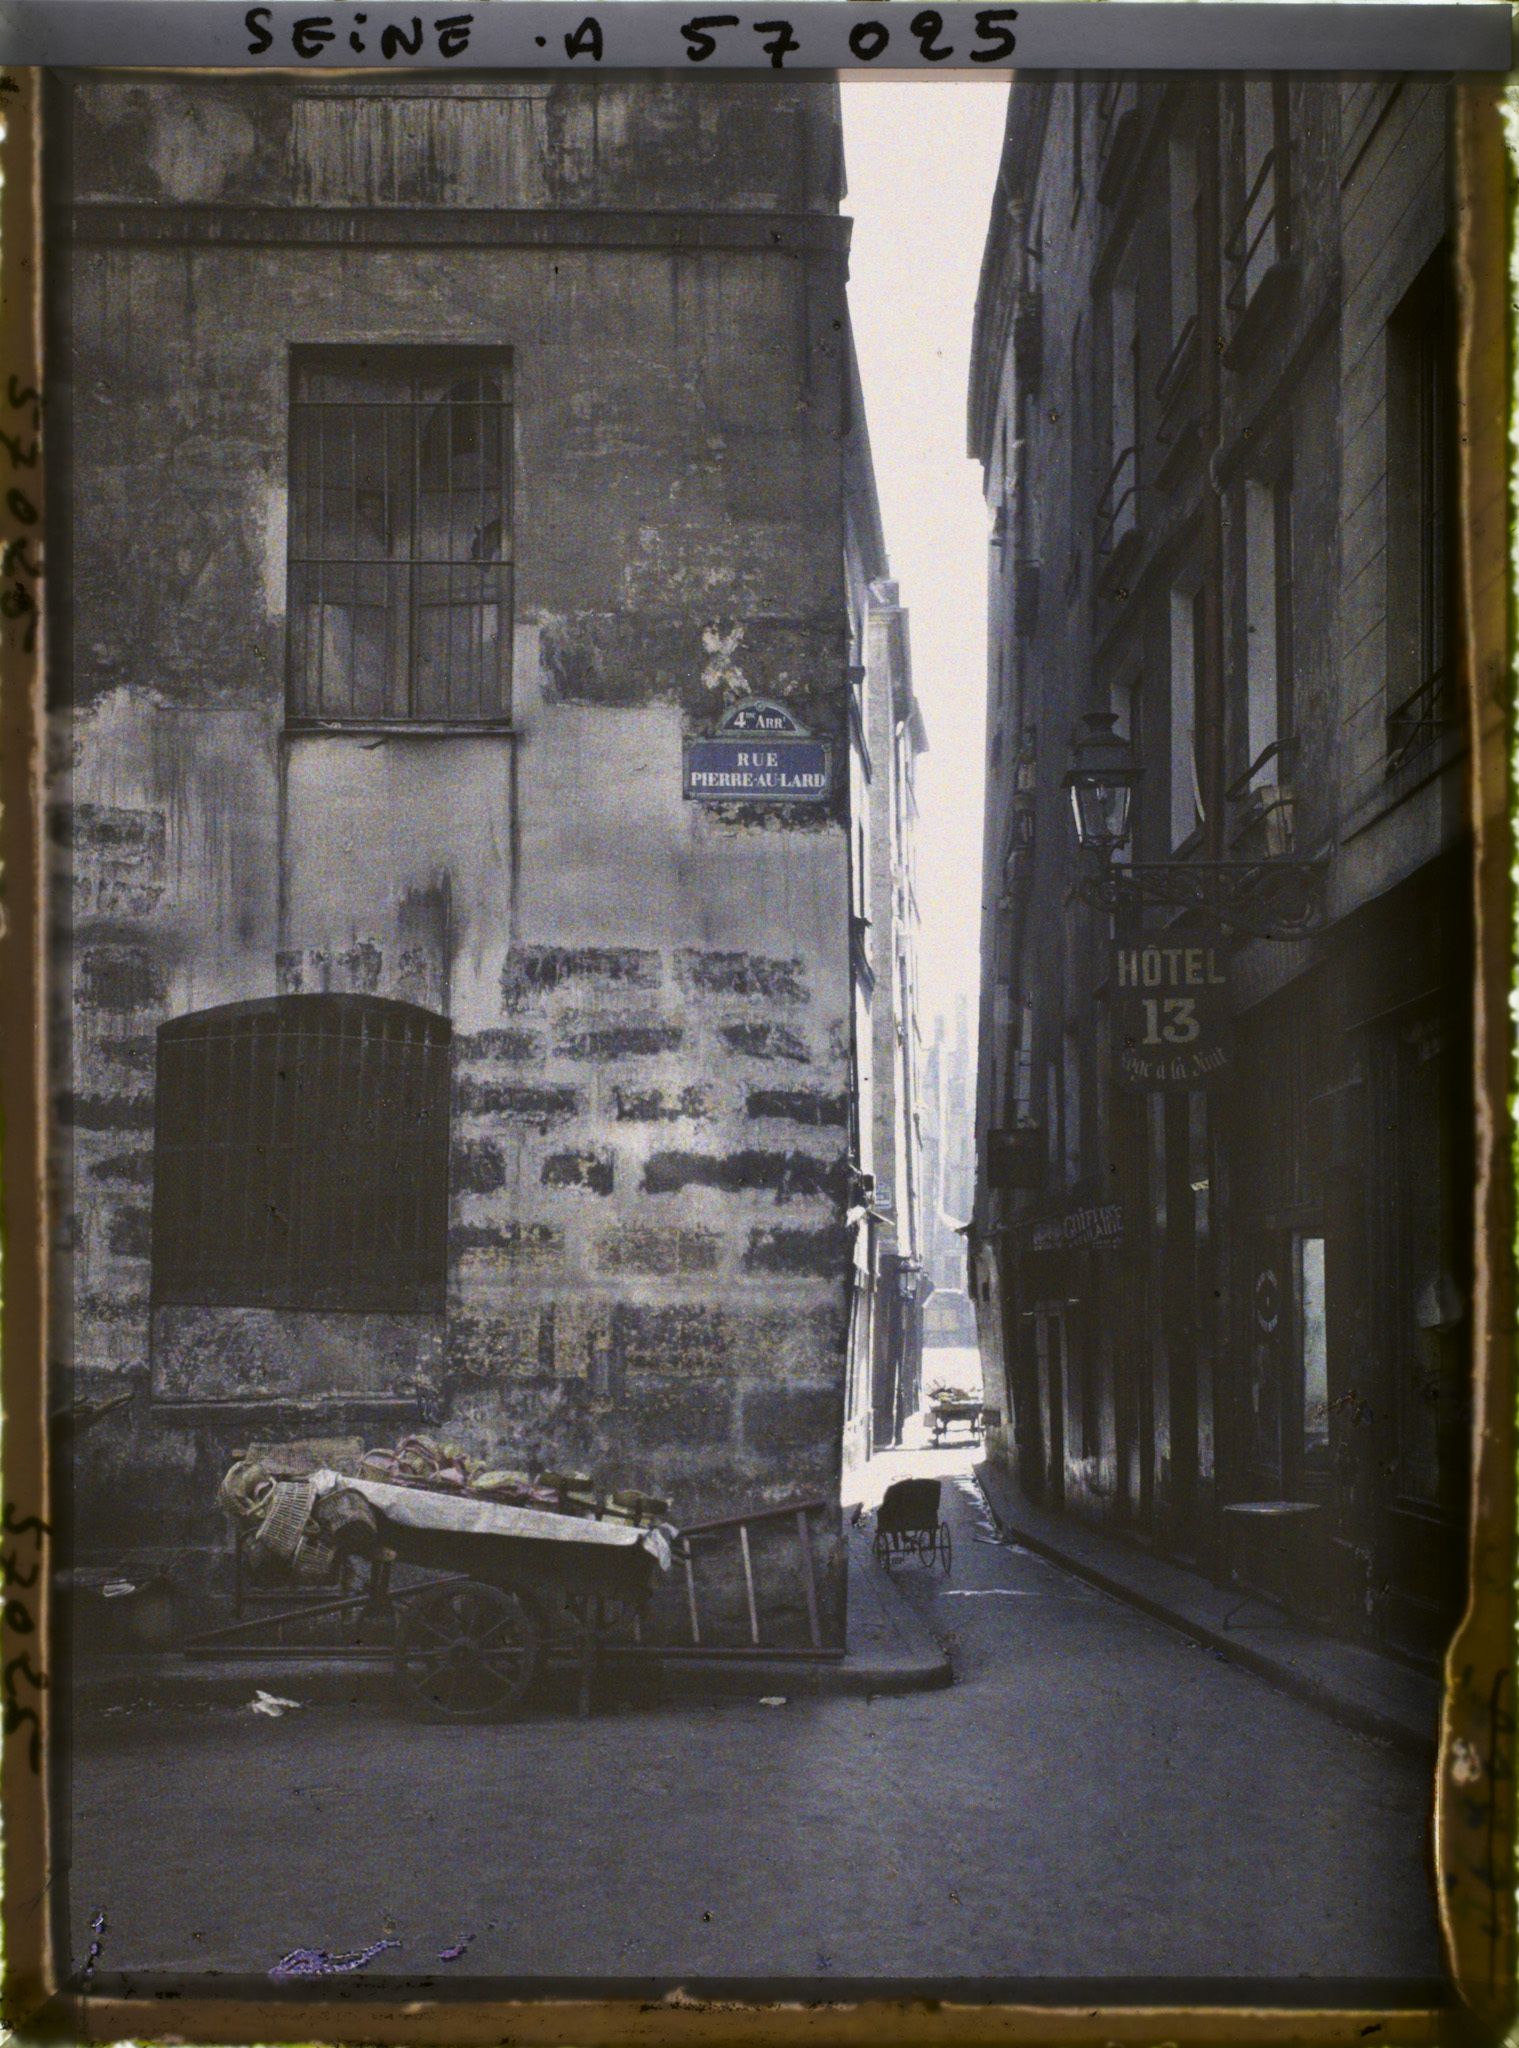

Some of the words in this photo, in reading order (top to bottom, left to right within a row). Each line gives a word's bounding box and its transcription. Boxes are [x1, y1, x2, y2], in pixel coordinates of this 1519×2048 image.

[737, 752, 778, 767] RUE
[690, 771, 826, 788] PIERRE-AU-LARD
[1117, 944, 1227, 987] HÔTEL
[1141, 998, 1201, 1045] 13
